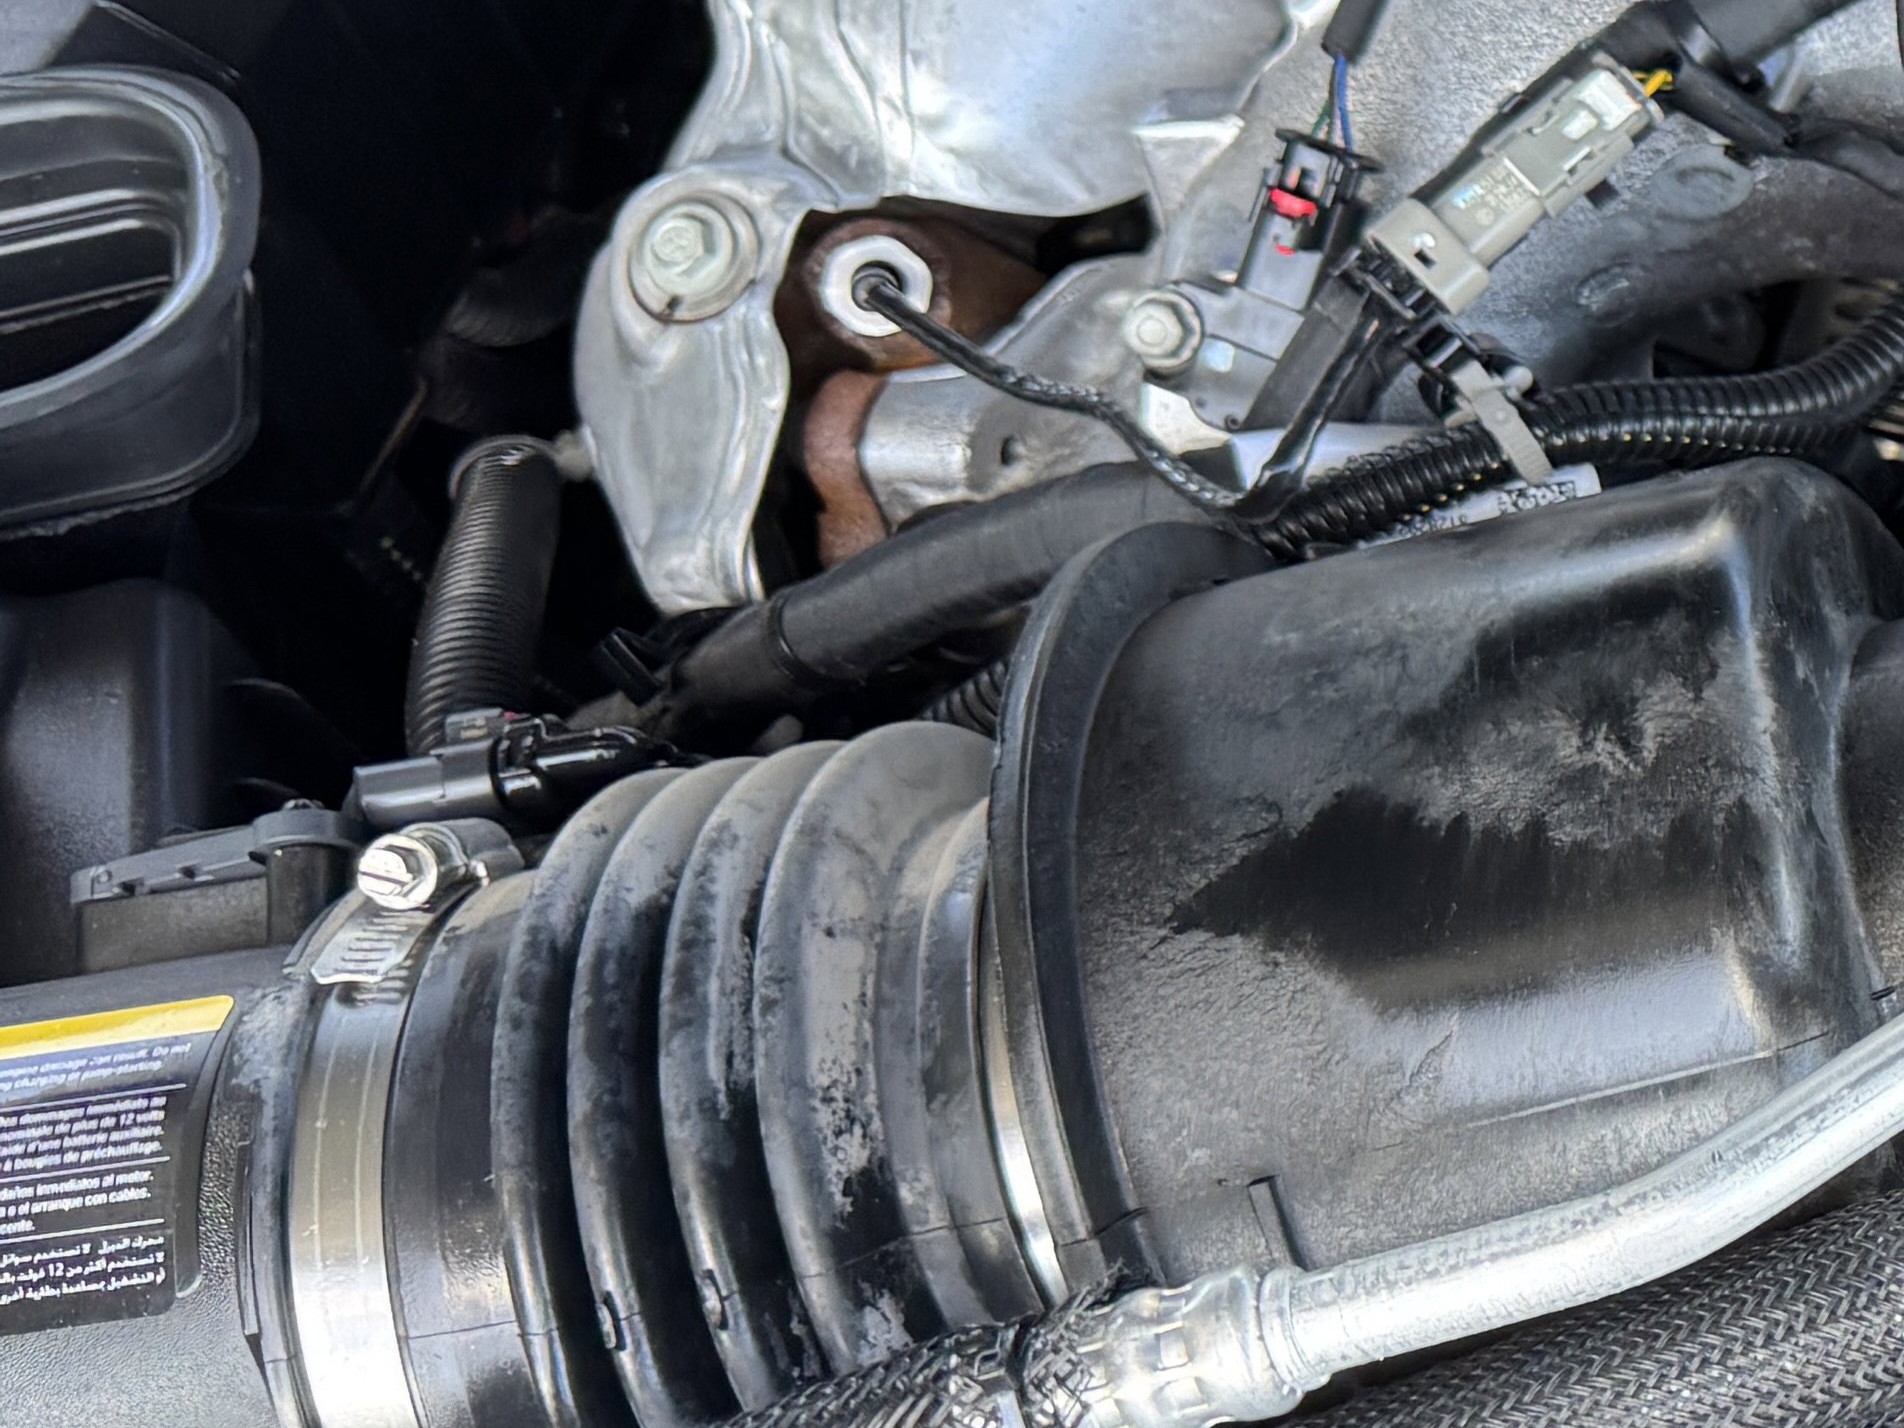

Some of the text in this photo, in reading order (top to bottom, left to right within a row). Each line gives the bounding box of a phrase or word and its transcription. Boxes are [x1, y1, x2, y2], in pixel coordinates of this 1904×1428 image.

[119, 1113, 135, 1126] 12
[31, 1196, 83, 1214] arranque
[85, 1193, 108, 1206] con
[48, 1262, 65, 1276] 12
